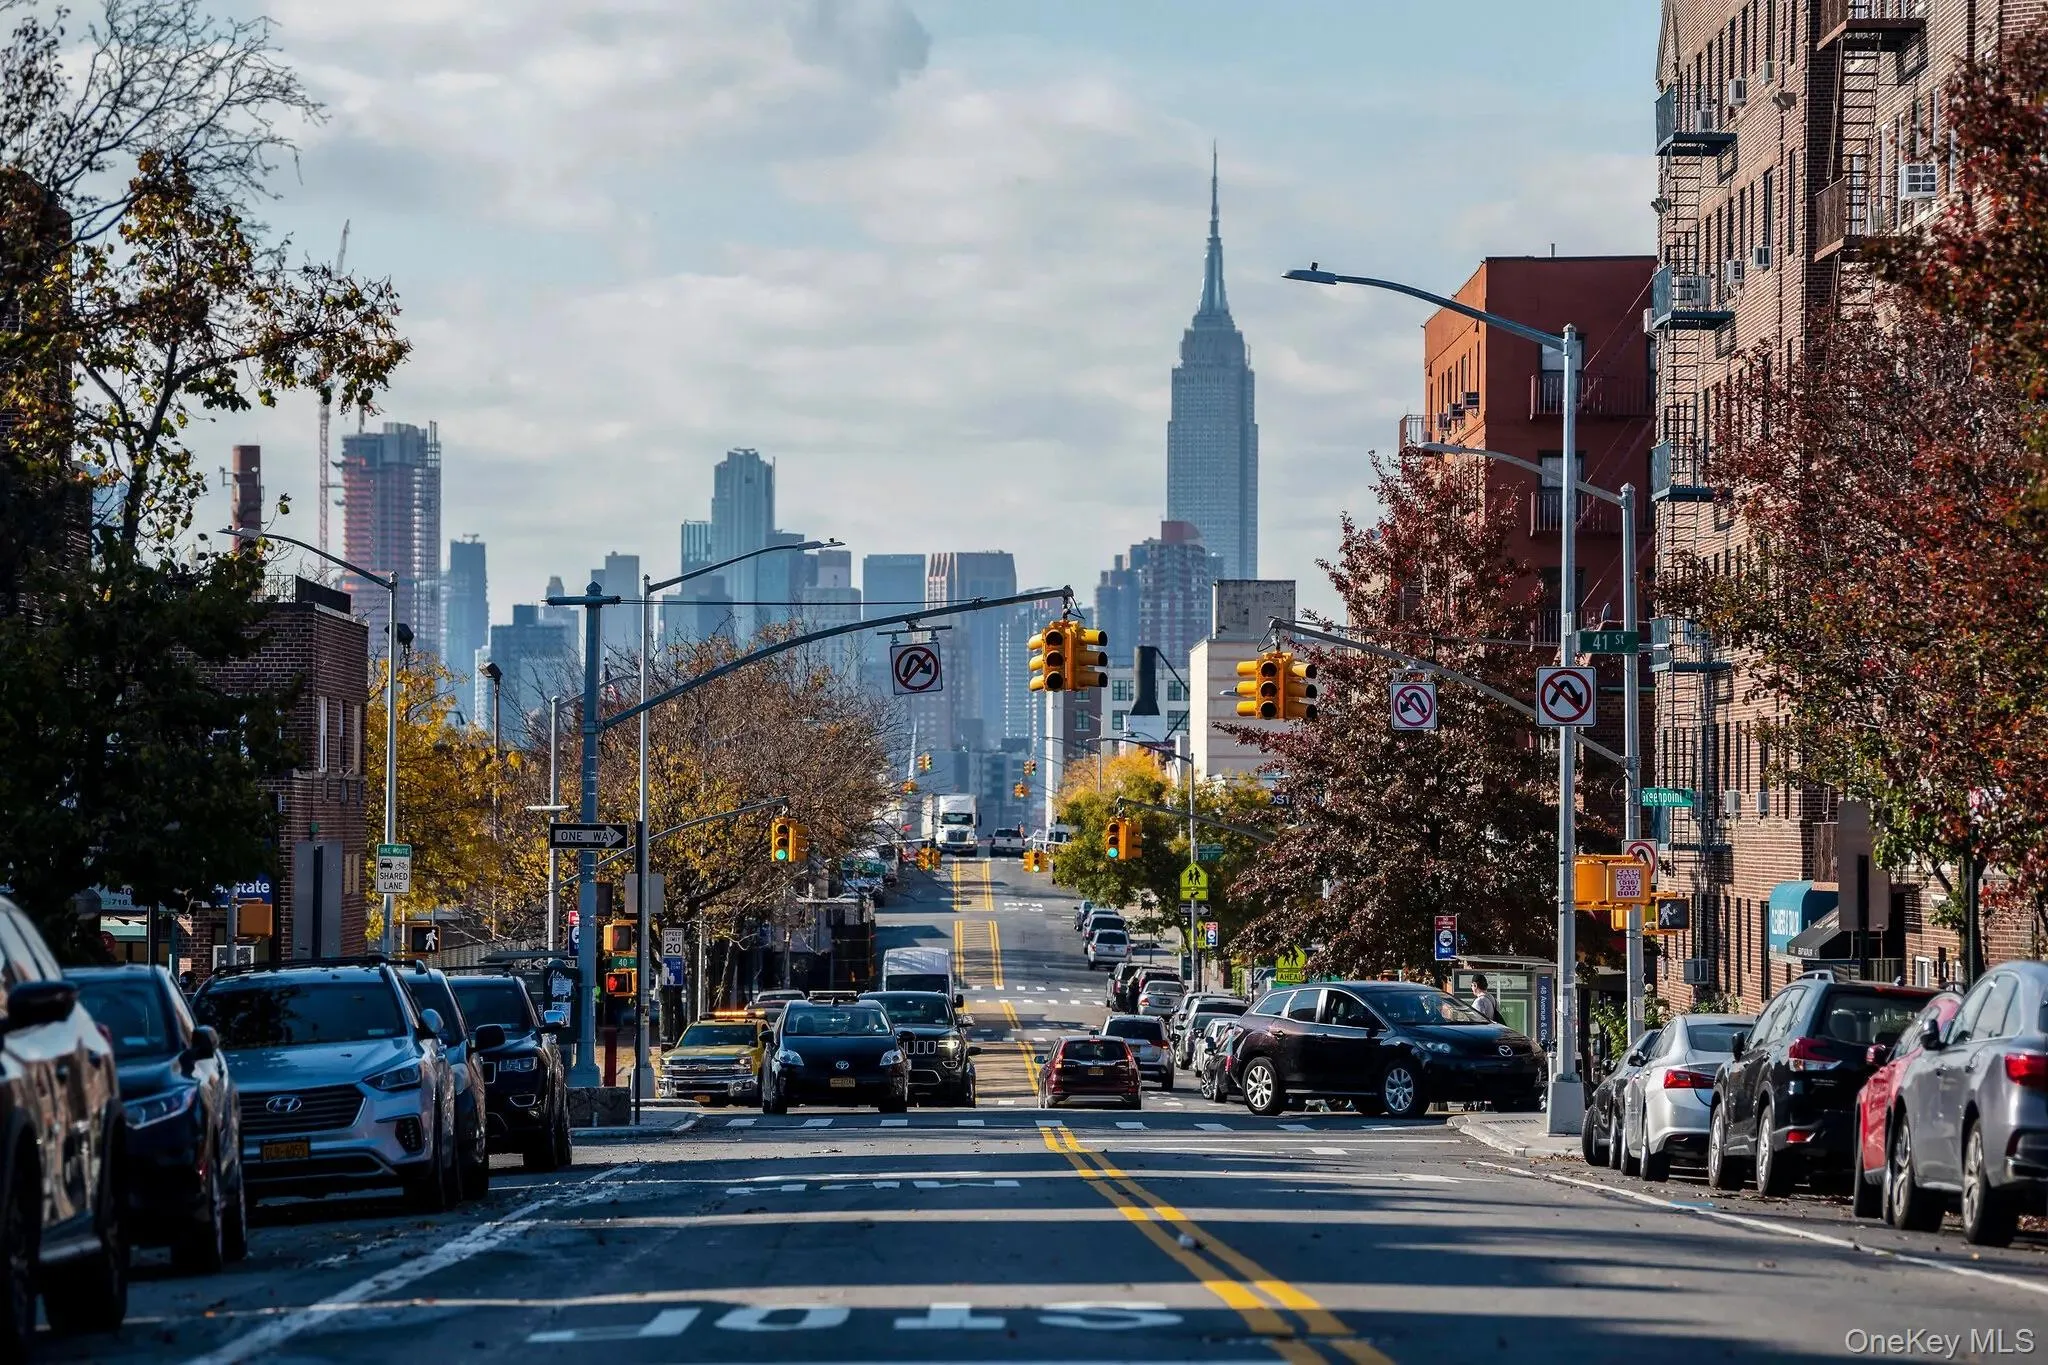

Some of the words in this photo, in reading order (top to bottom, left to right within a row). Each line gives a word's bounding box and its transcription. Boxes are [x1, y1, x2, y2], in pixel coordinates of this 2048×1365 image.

[1592, 634, 1608, 650] 41
[1615, 635, 1625, 645] St
[1641, 790, 1683, 806] Greenpoint
[560, 831, 583, 841] ONE
[592, 831, 616, 842] WAY
[379, 872, 408, 881] SHARED
[211, 880, 270, 894] Astate
[384, 882, 403, 890] LANE
[665, 943, 681, 954] 20
[618, 958, 628, 967] 40
